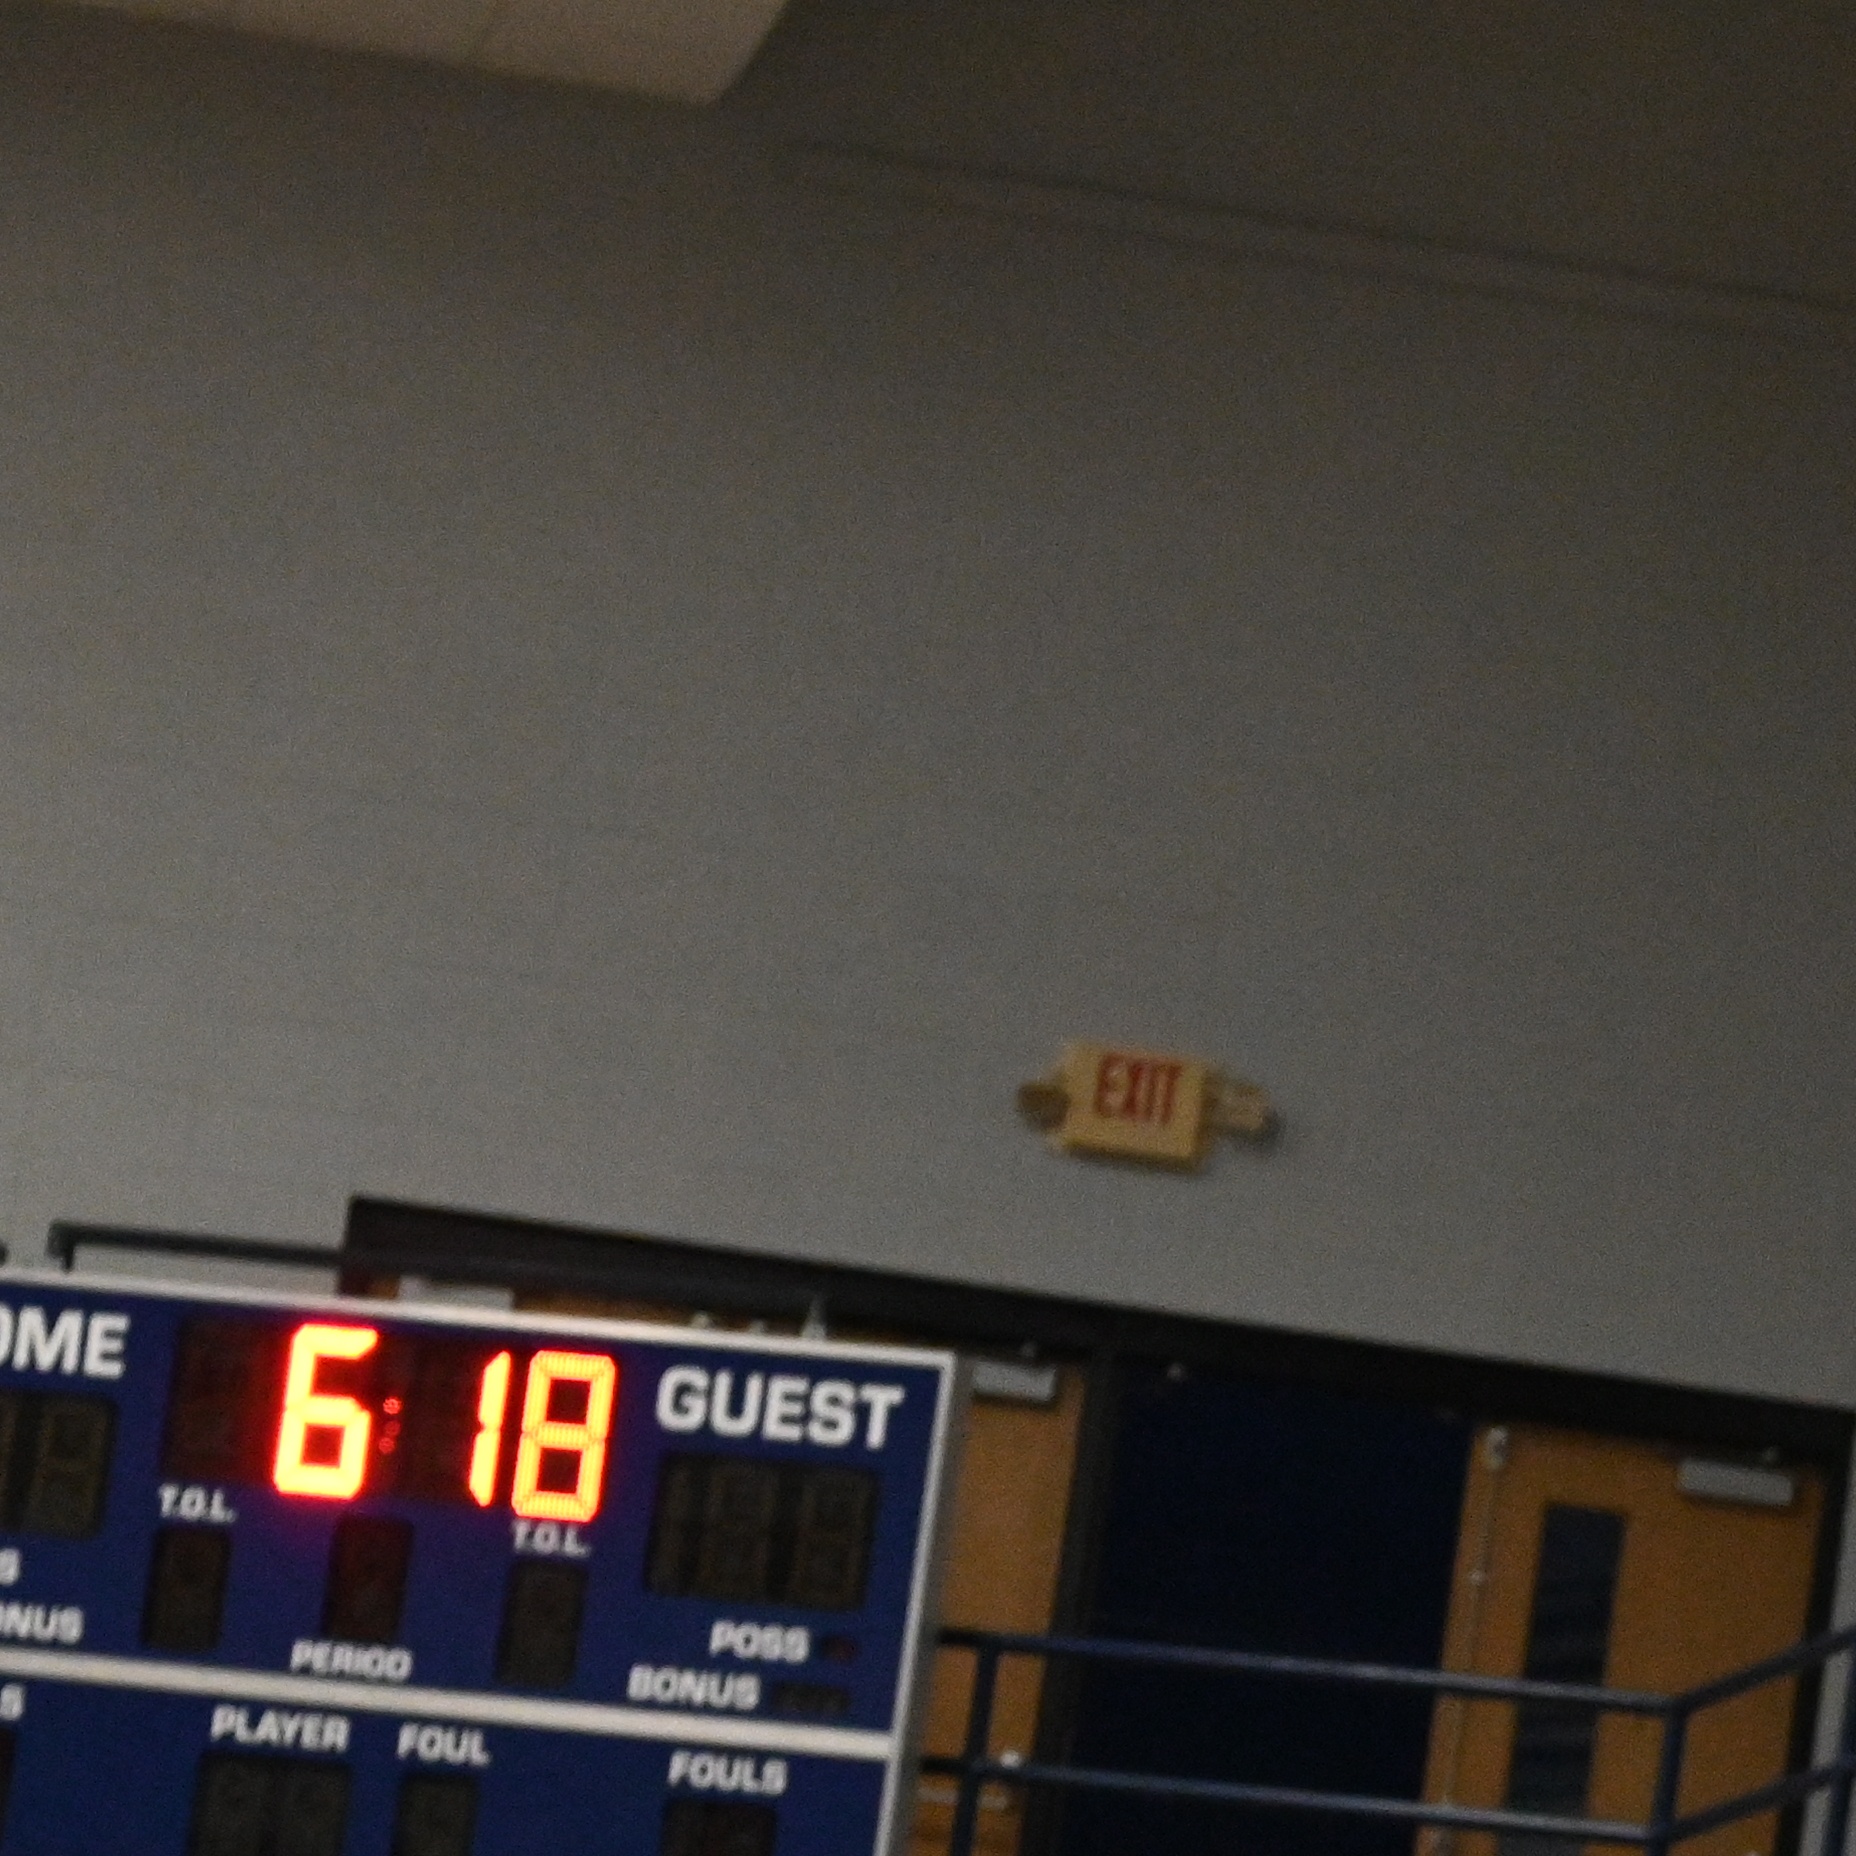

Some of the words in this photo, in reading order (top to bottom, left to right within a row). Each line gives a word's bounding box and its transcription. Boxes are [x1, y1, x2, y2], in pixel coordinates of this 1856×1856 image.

[1094, 1053, 1184, 1124] EXIT
[0, 1303, 131, 1379] ME
[656, 1364, 906, 1450] GUEST
[0, 1601, 84, 1645] NUS
[710, 1620, 810, 1663] POSS
[291, 1639, 412, 1682] PERIOD
[628, 1664, 761, 1711] BONUS
[211, 1704, 349, 1752] PLAYER
[397, 1722, 491, 1767] FOUL
[667, 1750, 787, 1795] FOULS
